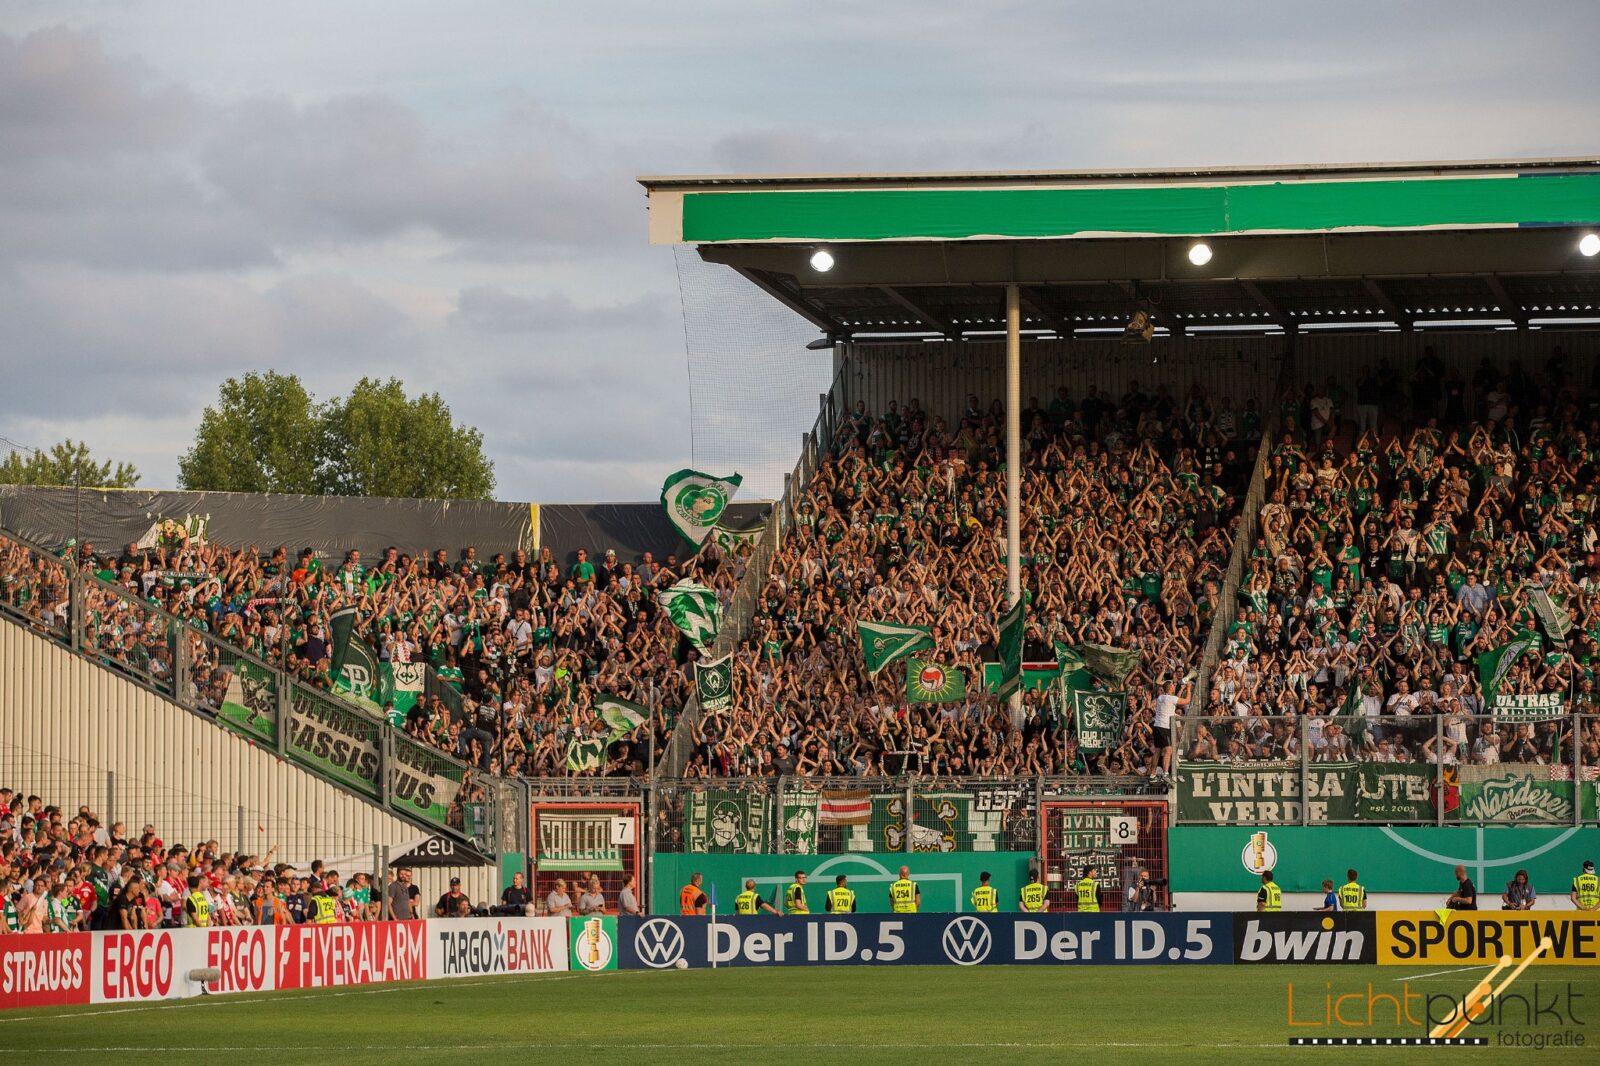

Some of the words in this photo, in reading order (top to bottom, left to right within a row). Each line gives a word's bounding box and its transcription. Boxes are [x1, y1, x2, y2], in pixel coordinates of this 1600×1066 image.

[1496, 693, 1560, 707] ULTRAS
[290, 715, 436, 810] RASSISUS
[1209, 802, 1328, 825] VERDE
[1506, 807, 1538, 821] Bremen
[618, 822, 626, 839] 7
[1118, 822, 1129, 838] 8
[540, 821, 619, 860] CAILLERA
[1068, 868, 1084, 878] DE
[1101, 866, 1117, 876] LA
[896, 890, 910, 898] 254
[1078, 890, 1090, 898] 115
[1582, 884, 1594, 892] 466
[837, 899, 849, 907] 270
[977, 898, 989, 906] 271
[1027, 894, 1041, 902] 265
[1345, 894, 1358, 903] 100
[707, 924, 793, 962] Der
[807, 922, 905, 962] ID.5
[1014, 921, 1100, 960] Der
[1114, 920, 1213, 960] ID.5
[1240, 918, 1365, 961] bwin
[1391, 919, 1600, 959] SPORTWE
[207, 928, 266, 992] ERGO
[300, 920, 424, 988] FLYERALARM
[2, 948, 82, 993] STRAUSS
[102, 931, 174, 999] ERGO
